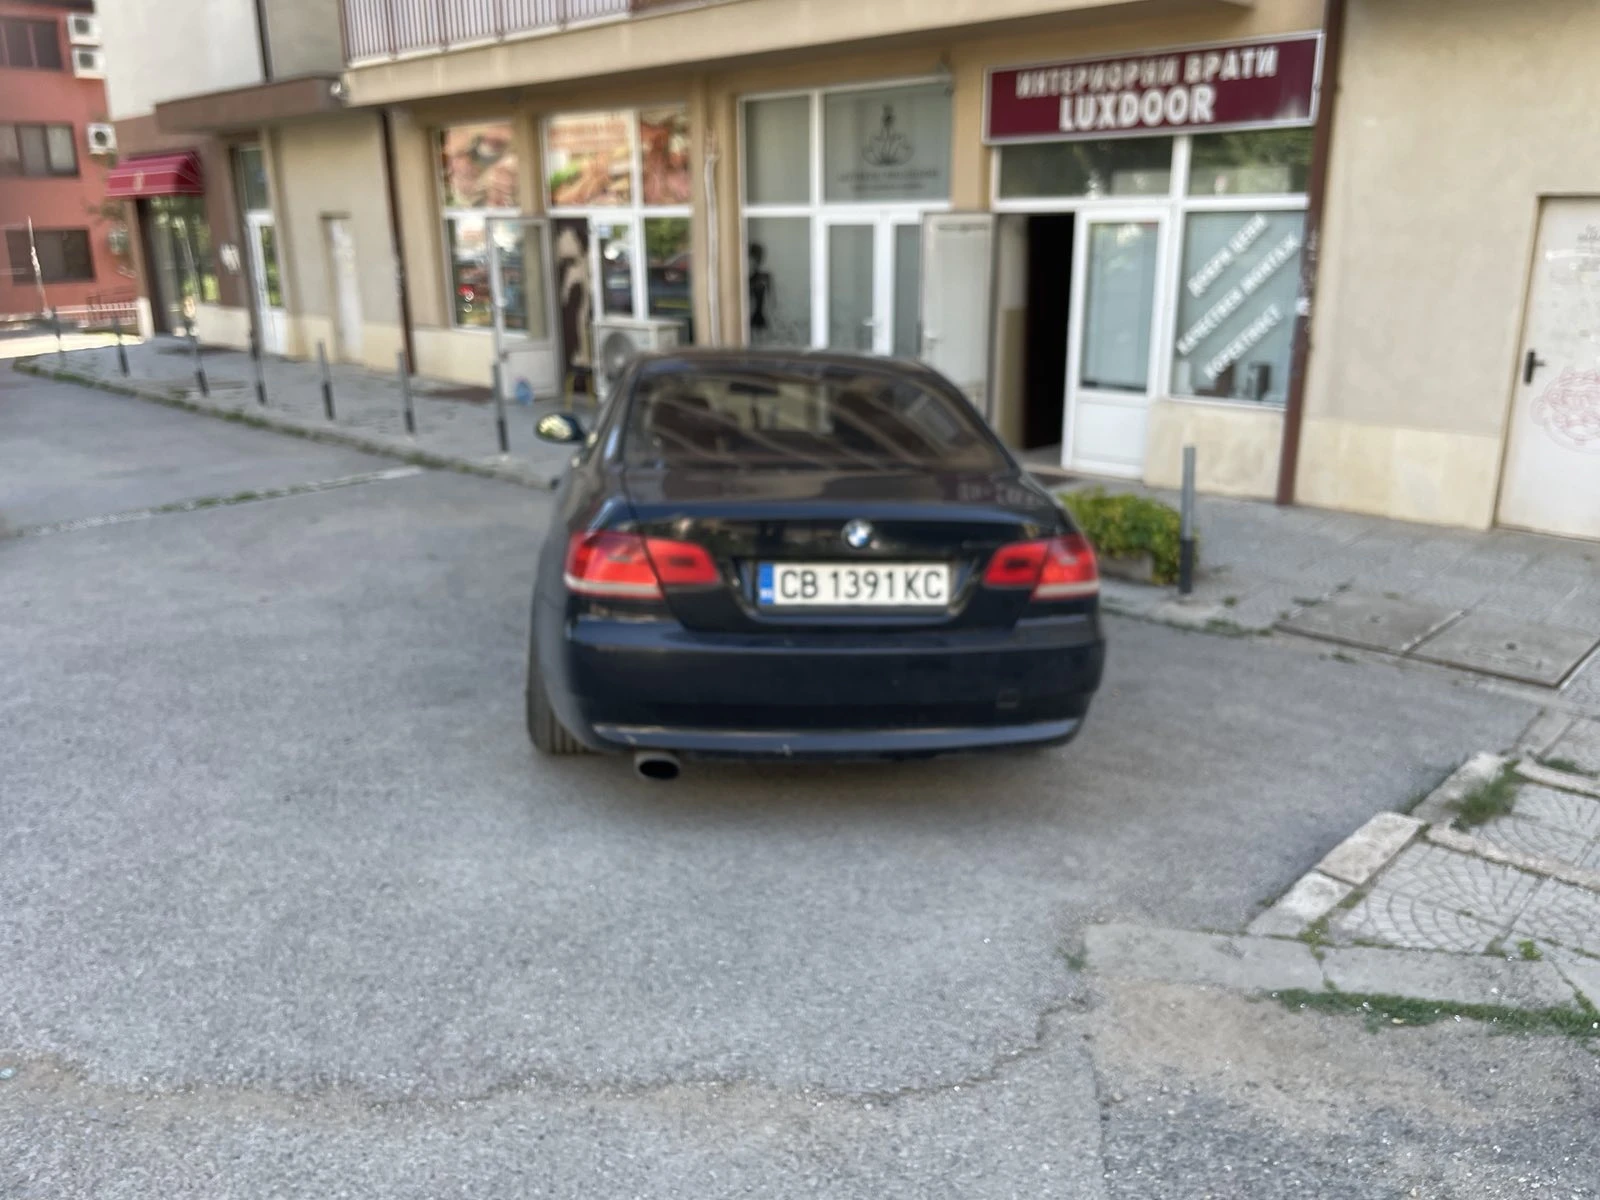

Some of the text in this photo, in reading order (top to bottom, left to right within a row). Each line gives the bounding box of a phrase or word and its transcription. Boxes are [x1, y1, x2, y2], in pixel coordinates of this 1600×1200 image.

[1016, 46, 1279, 98] ИНТЕРИОРНИ ВРАТИ
[1059, 84, 1216, 131] LUXDOOR
[830, 570, 895, 599] 1391
